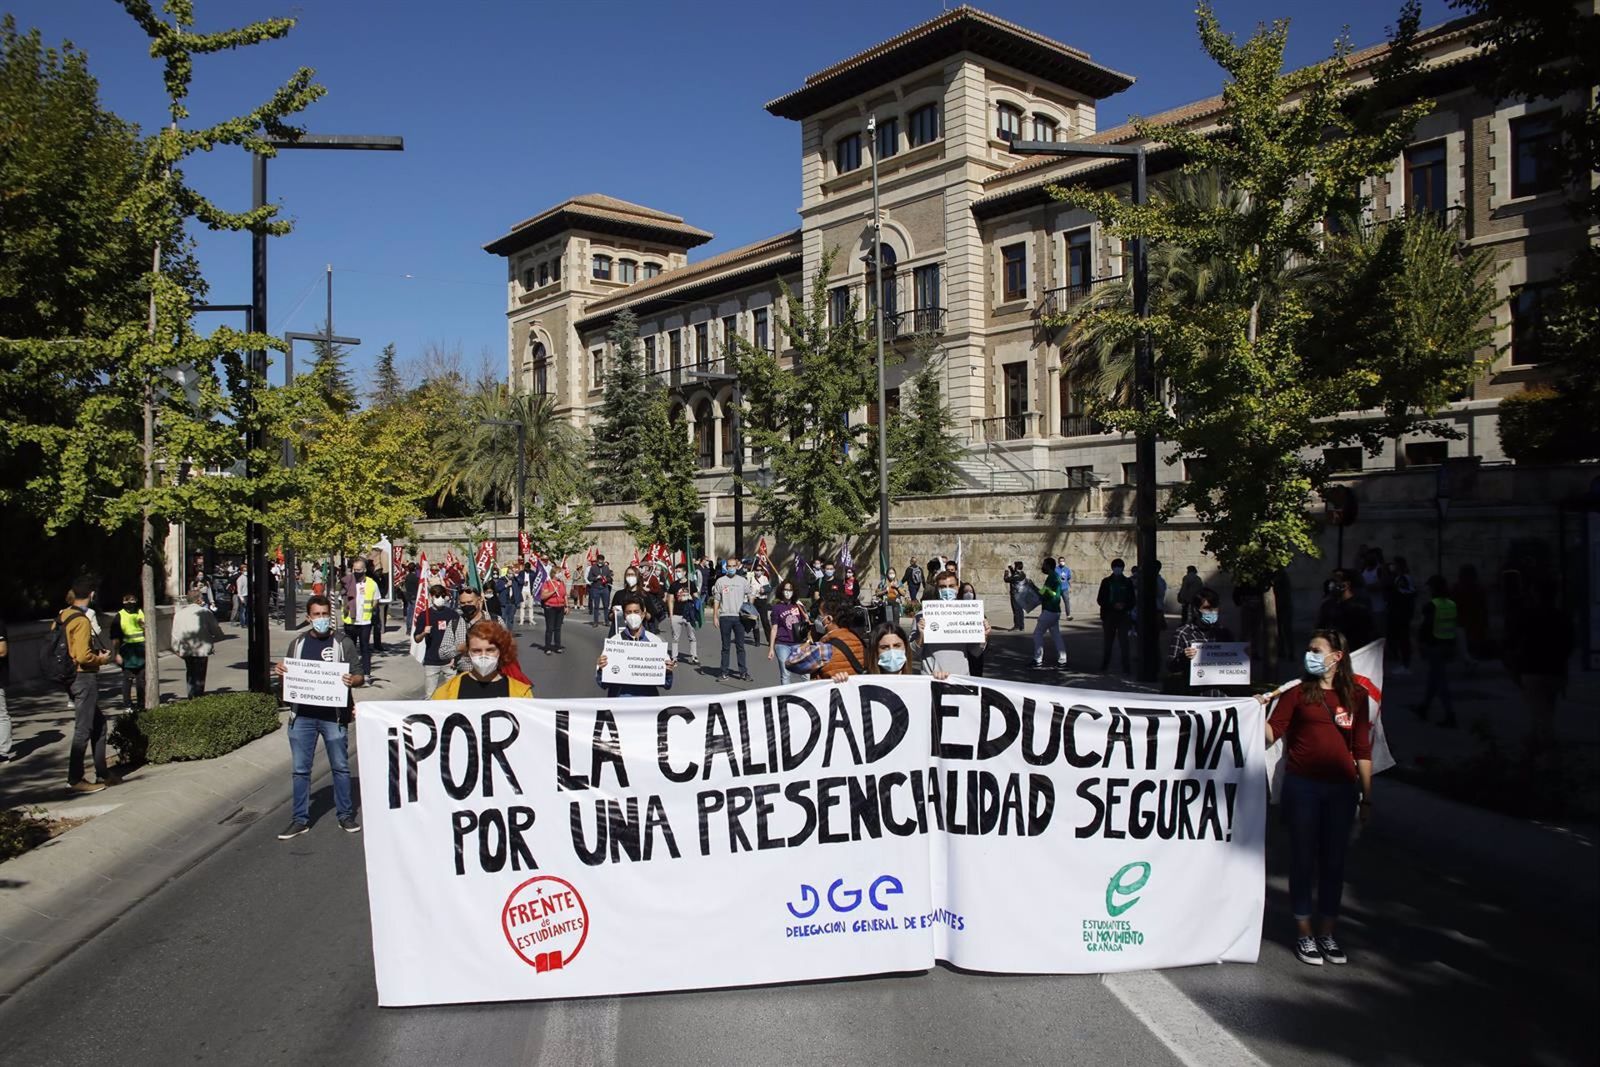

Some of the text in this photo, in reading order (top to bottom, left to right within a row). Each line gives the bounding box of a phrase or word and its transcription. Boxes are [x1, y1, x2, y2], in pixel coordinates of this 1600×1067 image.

[300, 693, 325, 701] DEPENDE
[555, 709, 629, 792] LA
[657, 684, 909, 783] CALIDAD
[930, 681, 1244, 770] EDUCATIVA
[452, 766, 1237, 876] POR UNA PRESENCIALIDAD SEGURA!
[508, 891, 575, 928] FRENTE
[541, 918, 550, 928] de
[852, 917, 899, 933] GENERAL
[904, 916, 917, 930] DE
[1083, 919, 1131, 930] ESTUDIANTES
[516, 917, 584, 950] ESTUDIANTES
[1083, 930, 1144, 945] EN MOVIMIENTO
[1087, 940, 1123, 952] GRANADA
